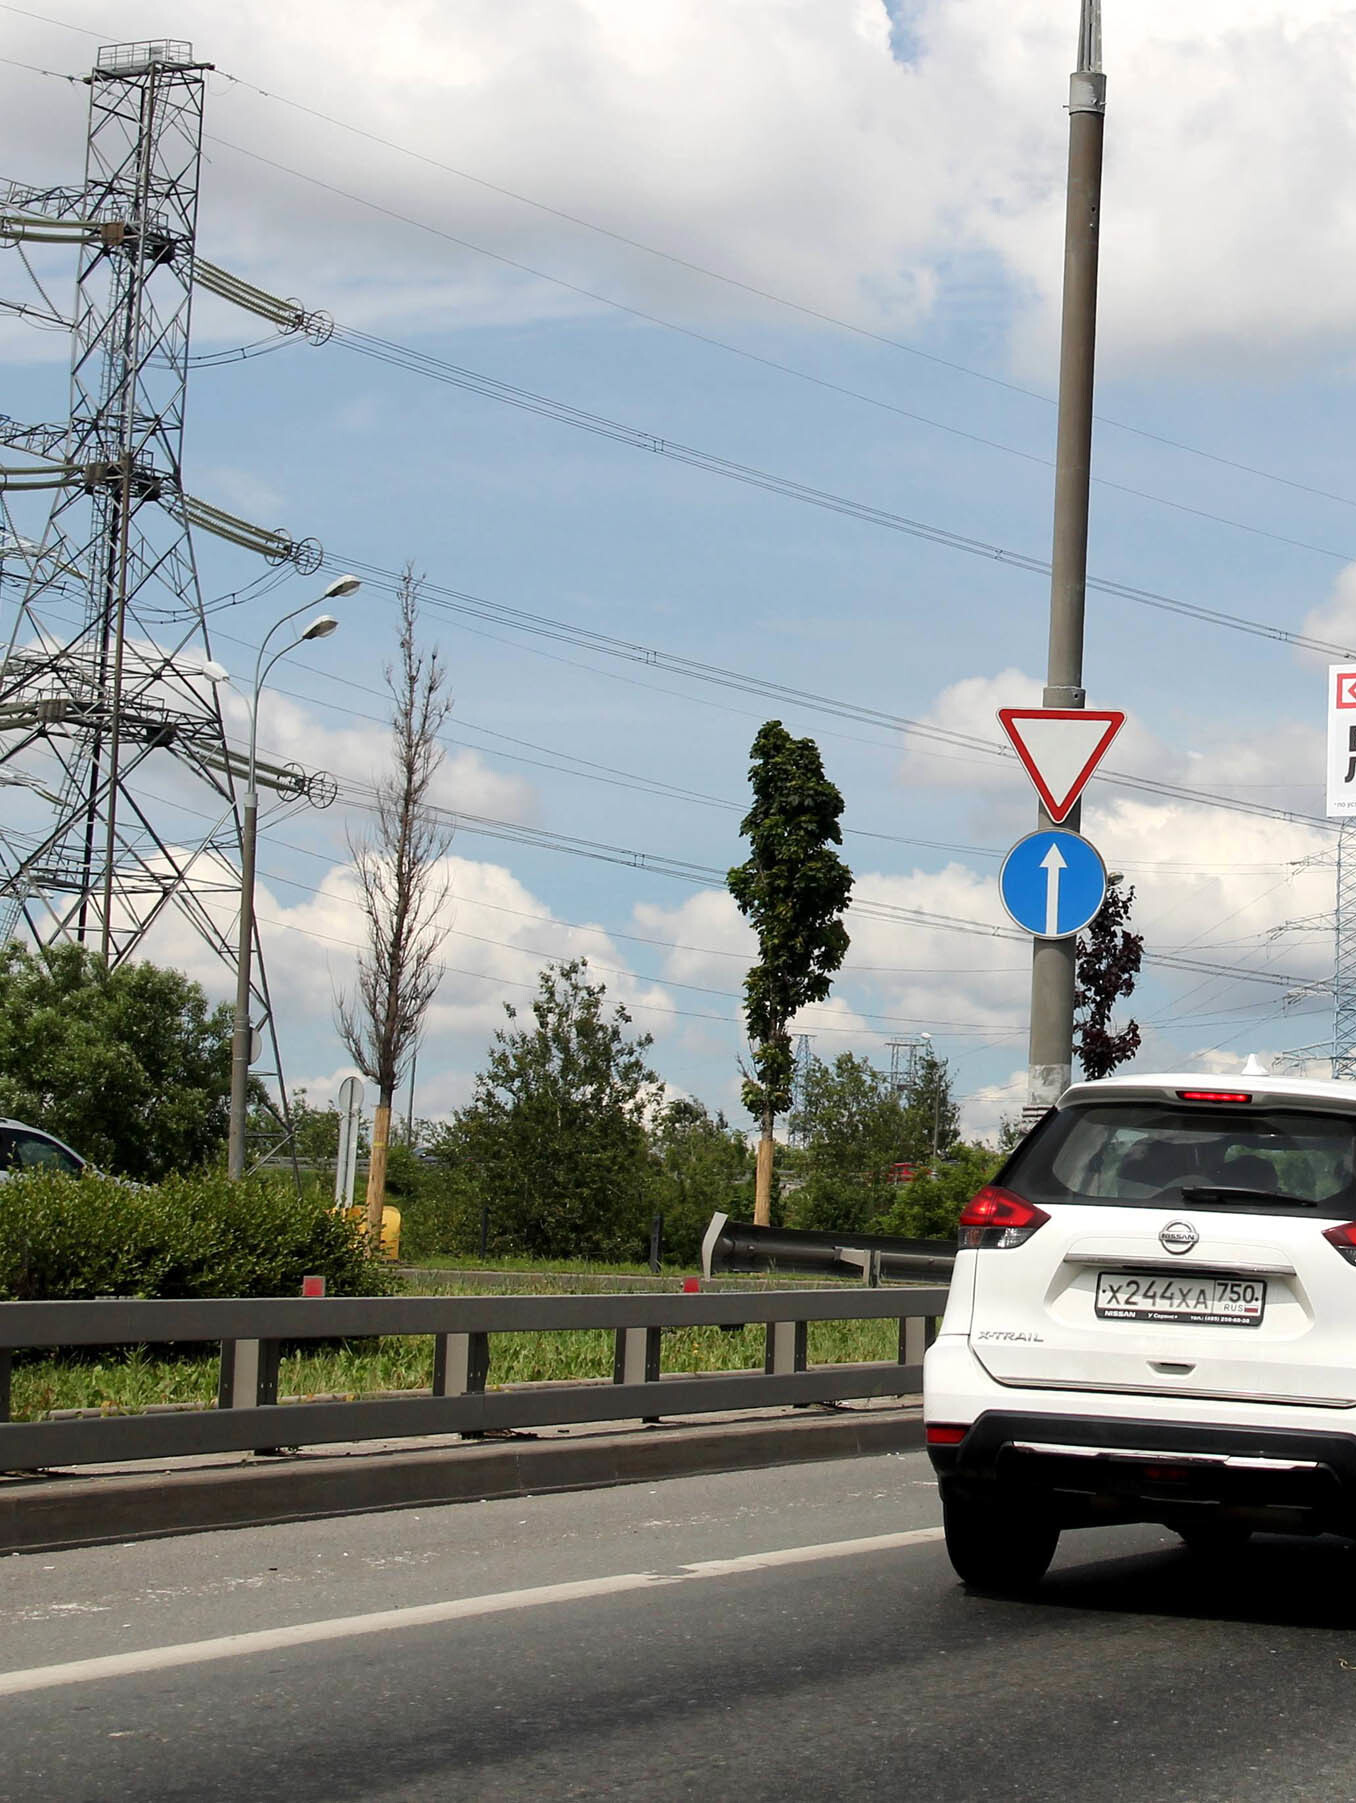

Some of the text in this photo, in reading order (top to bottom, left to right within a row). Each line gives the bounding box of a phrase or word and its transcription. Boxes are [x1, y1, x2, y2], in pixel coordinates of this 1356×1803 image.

[1216, 1282, 1256, 1304] 750
[1223, 1304, 1243, 1312] RUS
[1104, 1311, 1136, 1319] NISSAN
[978, 1331, 1044, 1343] X-TRAIL
